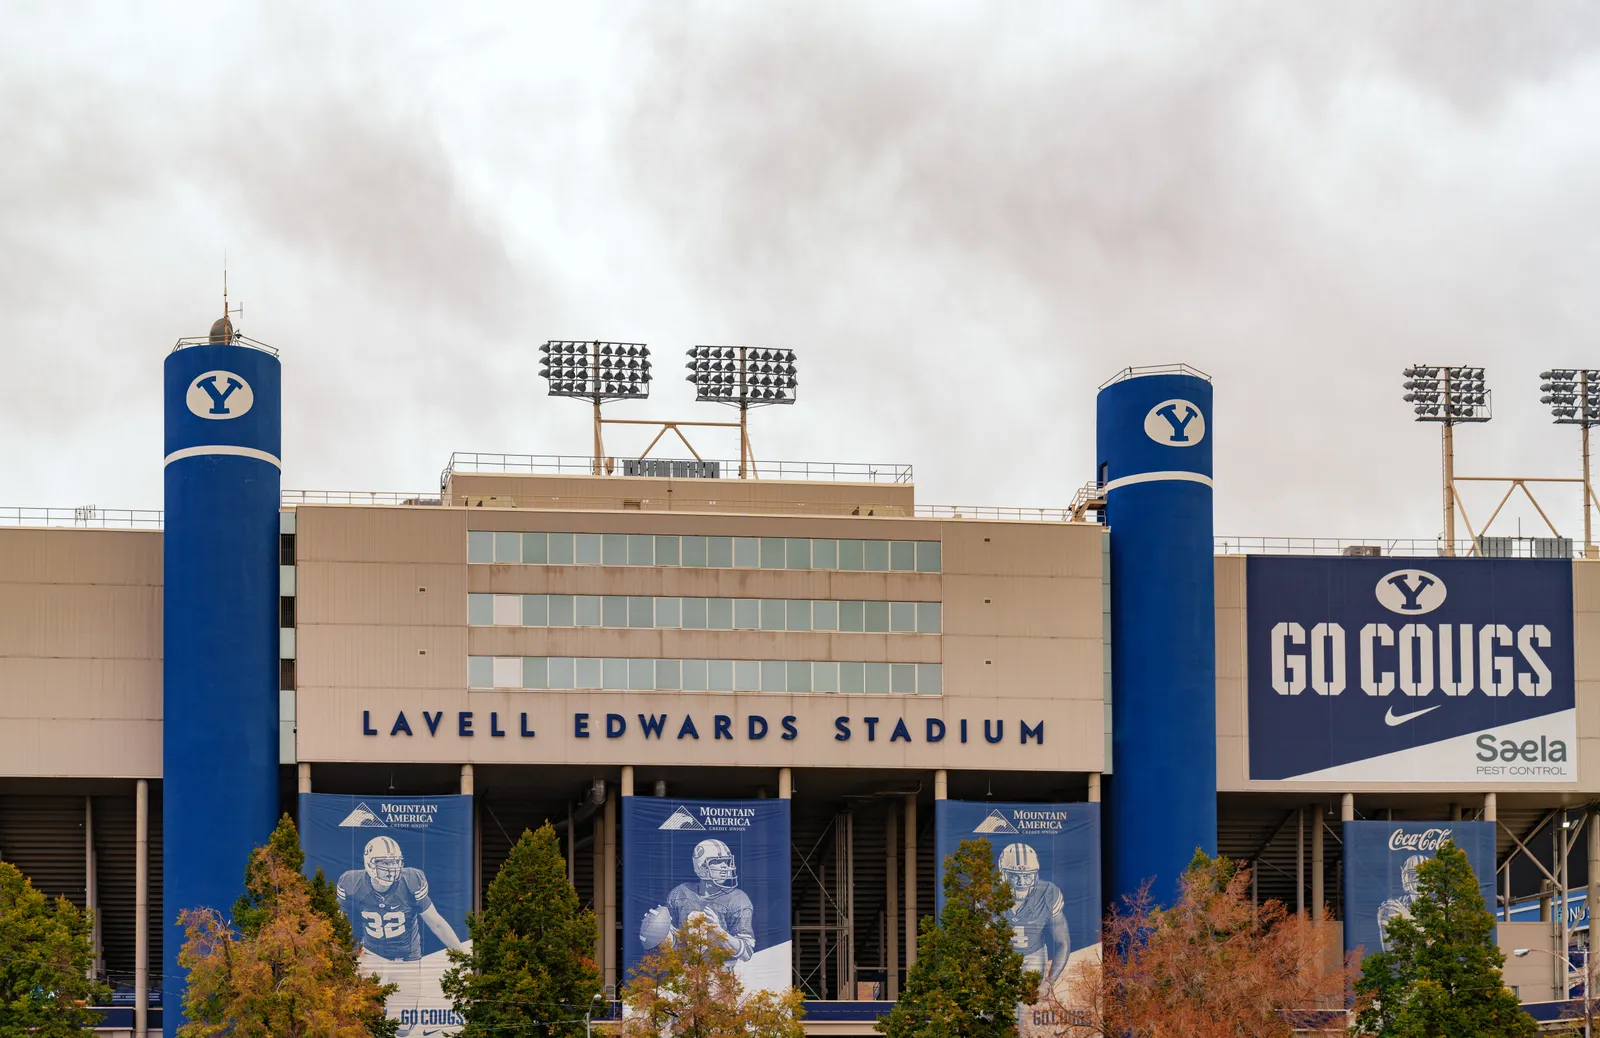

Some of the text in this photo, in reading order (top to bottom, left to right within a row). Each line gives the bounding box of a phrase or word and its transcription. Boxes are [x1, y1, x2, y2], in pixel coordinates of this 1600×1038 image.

[196, 375, 243, 414] Y
[1155, 404, 1198, 442] Y
[1387, 574, 1435, 610] Y
[1271, 622, 1552, 696] GO COUGS
[363, 710, 1044, 744] LAVELL EDWARDS STADIUM
[1476, 733, 1567, 762] Saela
[1476, 766, 1567, 775] PEST CONTROL
[381, 803, 438, 813] MOUNTAIN
[700, 806, 755, 817] MOUNTAIN
[1013, 810, 1067, 820] MOUNTAIN
[385, 813, 434, 823] AMERICA
[704, 816, 751, 826] AMERICA
[1017, 819, 1063, 829] AMERICA
[361, 911, 406, 939] 32
[401, 1009, 465, 1025] GO COUGS
